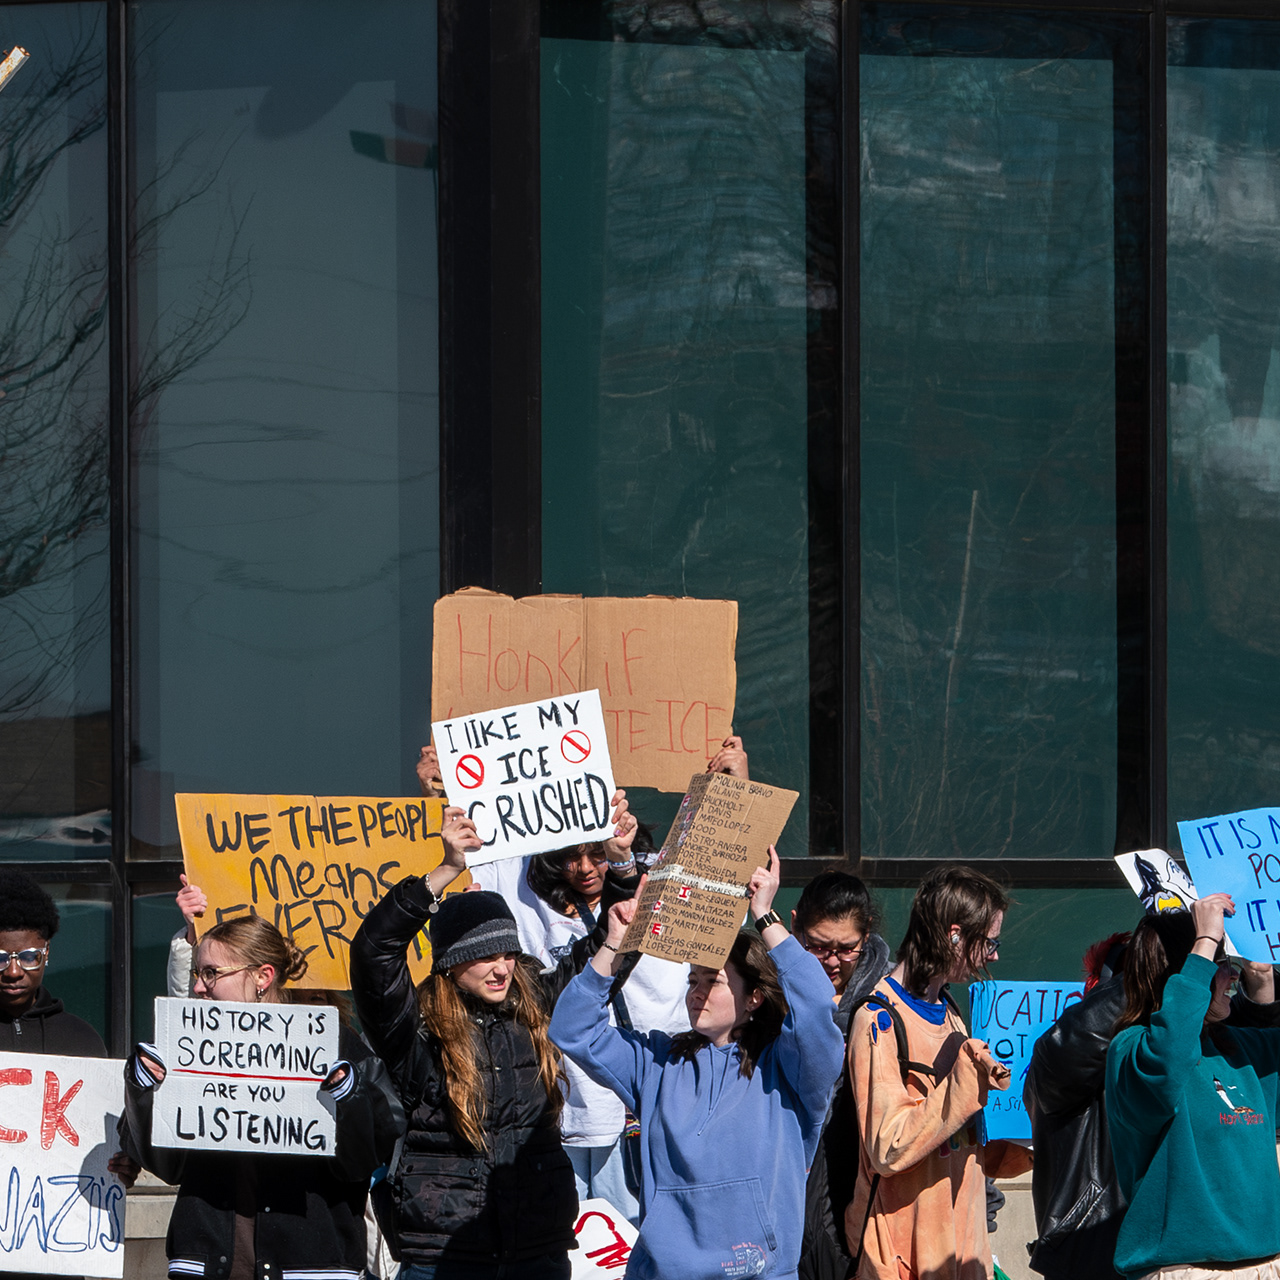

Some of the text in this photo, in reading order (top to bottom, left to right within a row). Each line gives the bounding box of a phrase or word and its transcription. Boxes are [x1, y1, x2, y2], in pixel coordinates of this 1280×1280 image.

[537, 700, 580, 730] MY
[655, 699, 727, 760] ICE
[497, 745, 552, 785] ICE
[711, 785, 741, 799] ALANIS
[468, 771, 610, 847] CRUSHED
[708, 806, 731, 818] DAVIS
[206, 800, 445, 854] WE THE PEOPL
[699, 813, 750, 833] MATEO LOPEZ
[1197, 822, 1224, 859] IT
[1228, 817, 1262, 849] IS
[695, 862, 736, 878] MOSQUEDA
[695, 903, 735, 919] BALTAZAR
[707, 916, 734, 928] VALDEZ
[1246, 899, 1267, 932] IT
[672, 918, 715, 935] MARTINEZ
[646, 941, 672, 954] LOPEZ
[674, 948, 699, 961] LOPEZ
[648, 932, 685, 947] VILLEGAS
[182, 1006, 294, 1041] HISTORY
[177, 1036, 328, 1076] SCREAMING
[203, 1082, 286, 1103] ARE YOU
[176, 1105, 327, 1151] LISTENING
